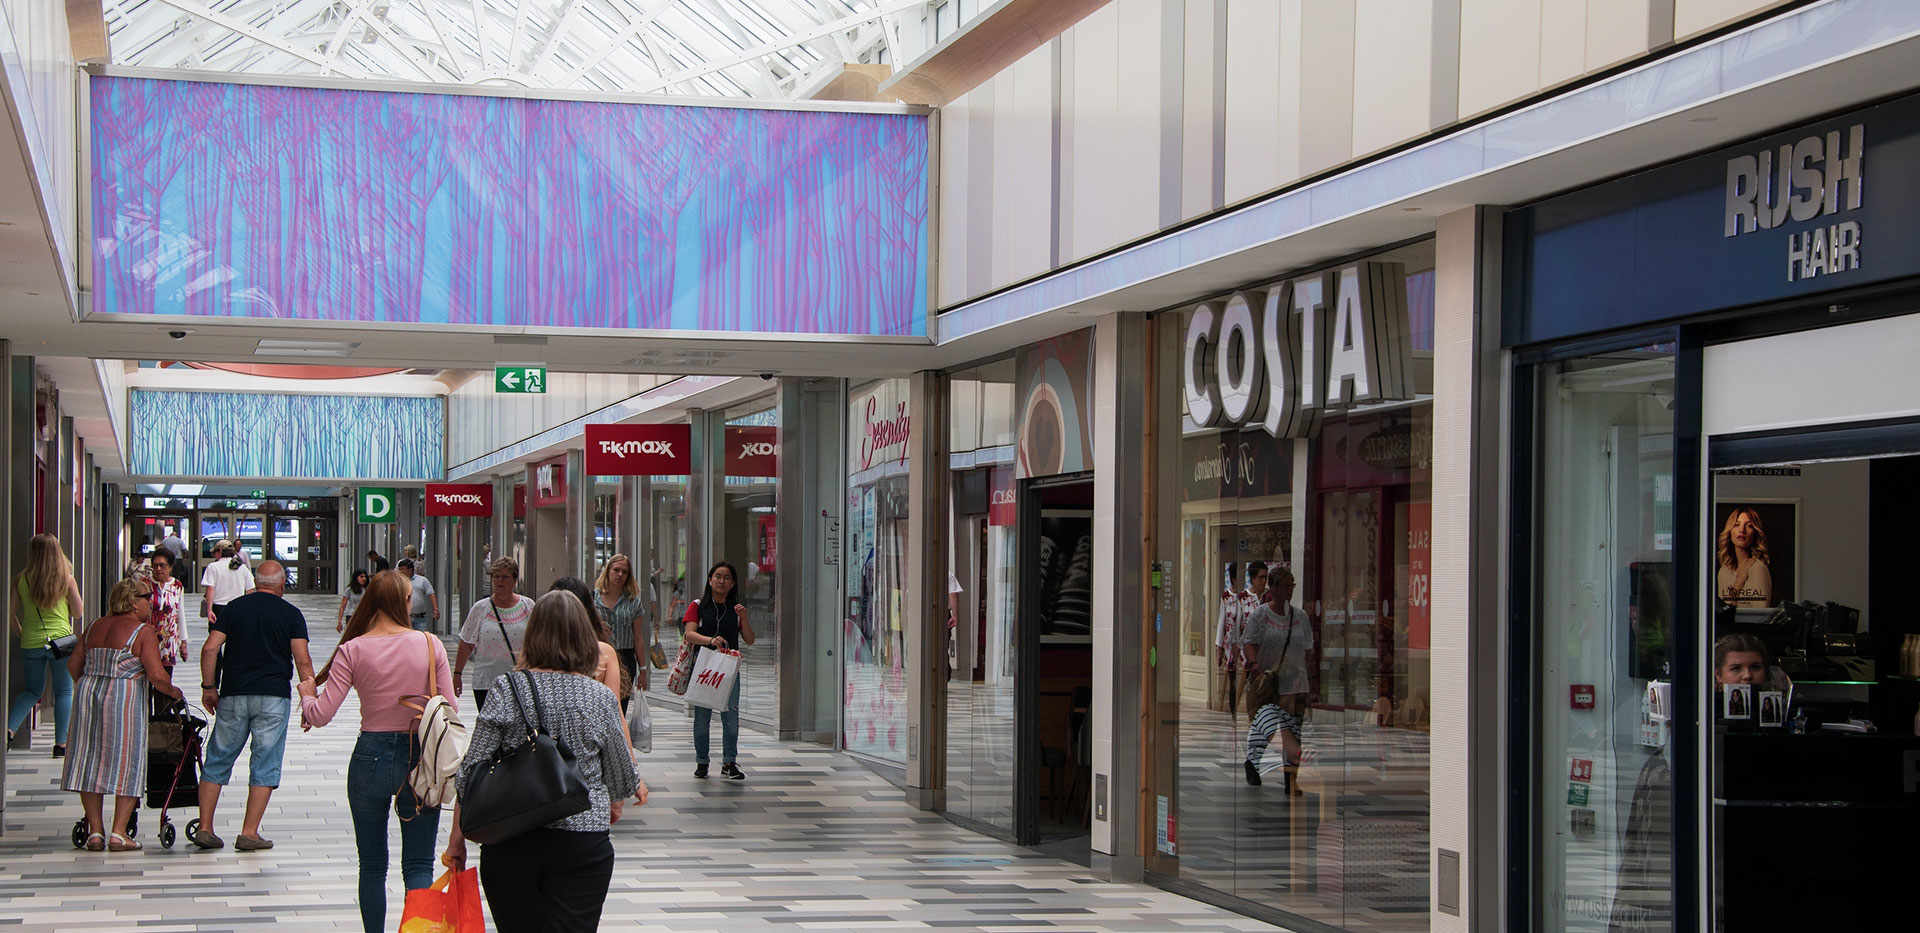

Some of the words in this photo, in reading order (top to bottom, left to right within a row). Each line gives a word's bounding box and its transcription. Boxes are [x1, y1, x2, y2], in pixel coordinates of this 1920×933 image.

[1724, 124, 1863, 238] RUSH
[1787, 220, 1863, 282] HAIR
[1184, 265, 1371, 439] COSTA
[861, 395, 911, 471] Serenity
[366, 494, 391, 518] D
[695, 668, 726, 690] H&M
